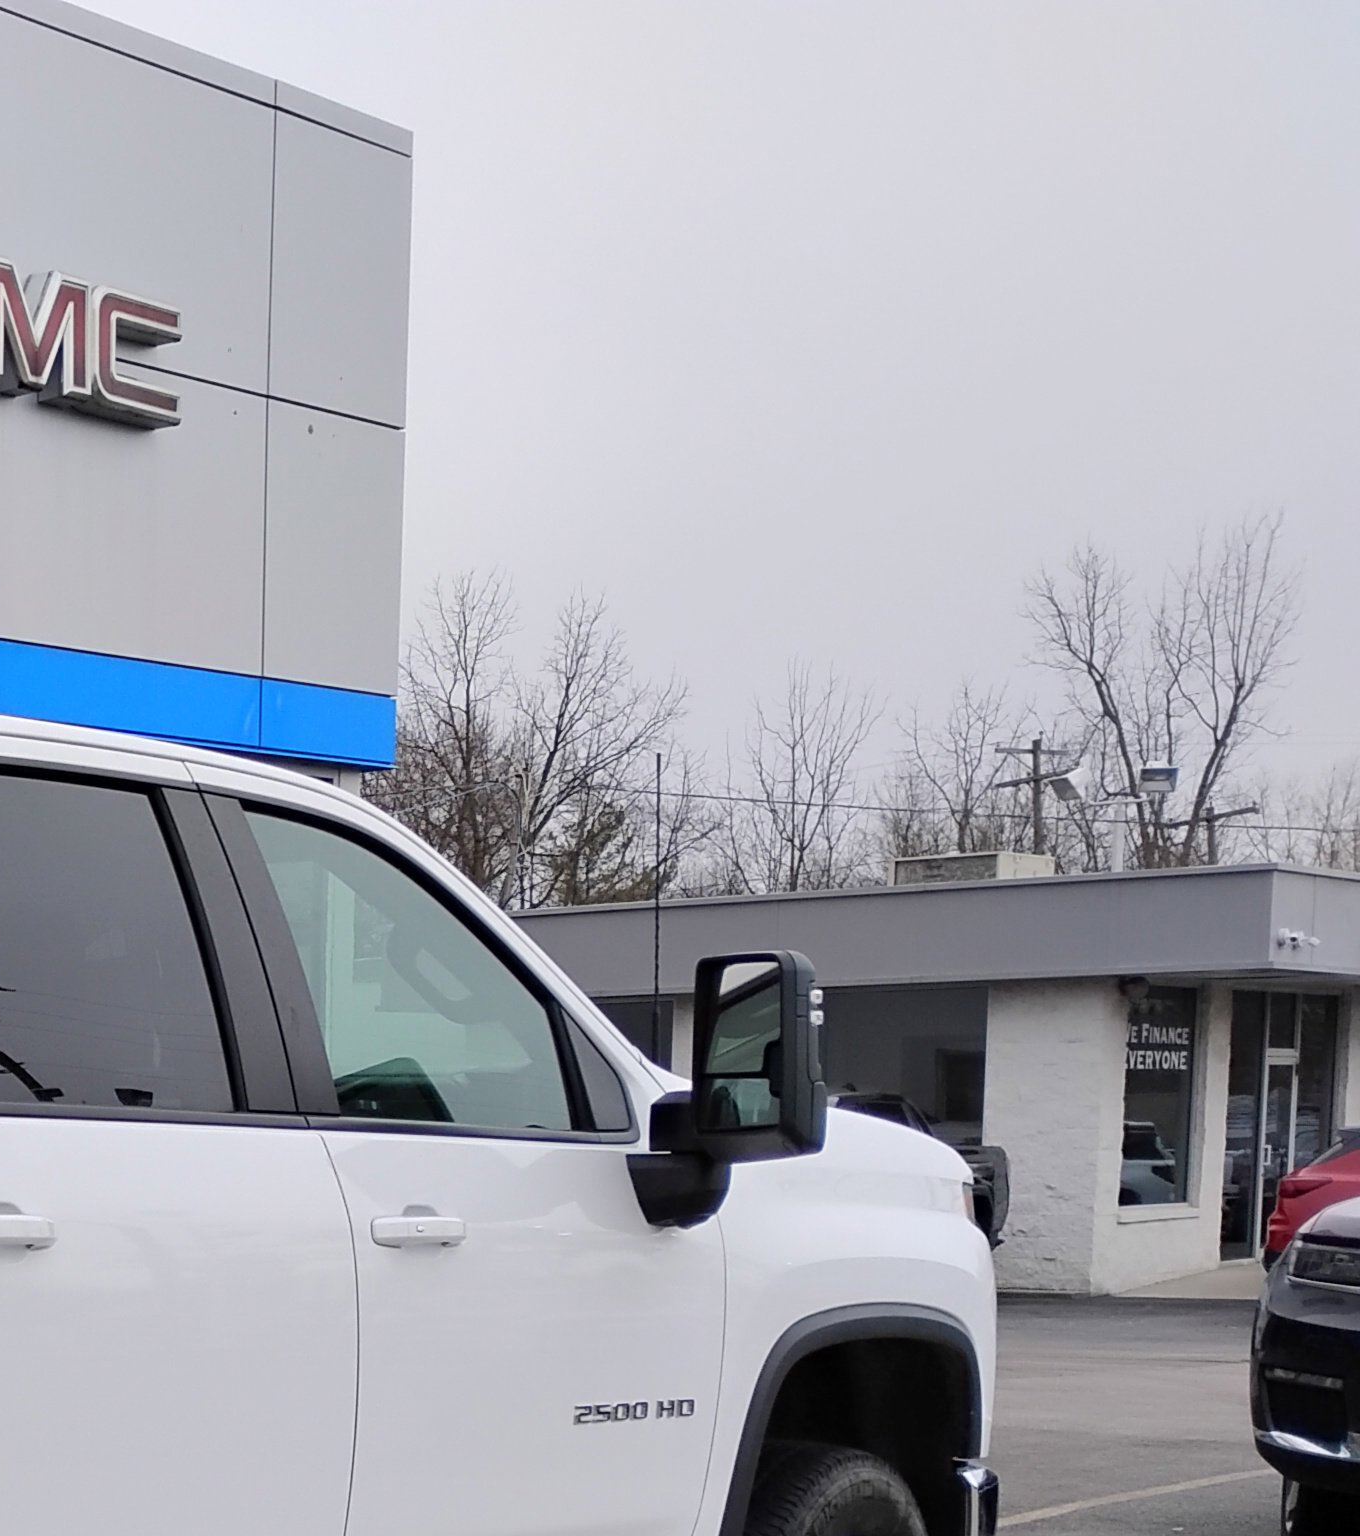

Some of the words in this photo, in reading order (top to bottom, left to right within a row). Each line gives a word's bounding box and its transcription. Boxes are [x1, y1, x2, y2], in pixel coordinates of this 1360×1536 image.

[1126, 1022, 1139, 1043] E
[1141, 1023, 1190, 1045] FINANCE
[1125, 1049, 1188, 1070] VERYONE
[573, 1402, 649, 1426] 2500
[655, 1399, 695, 1420] HD
